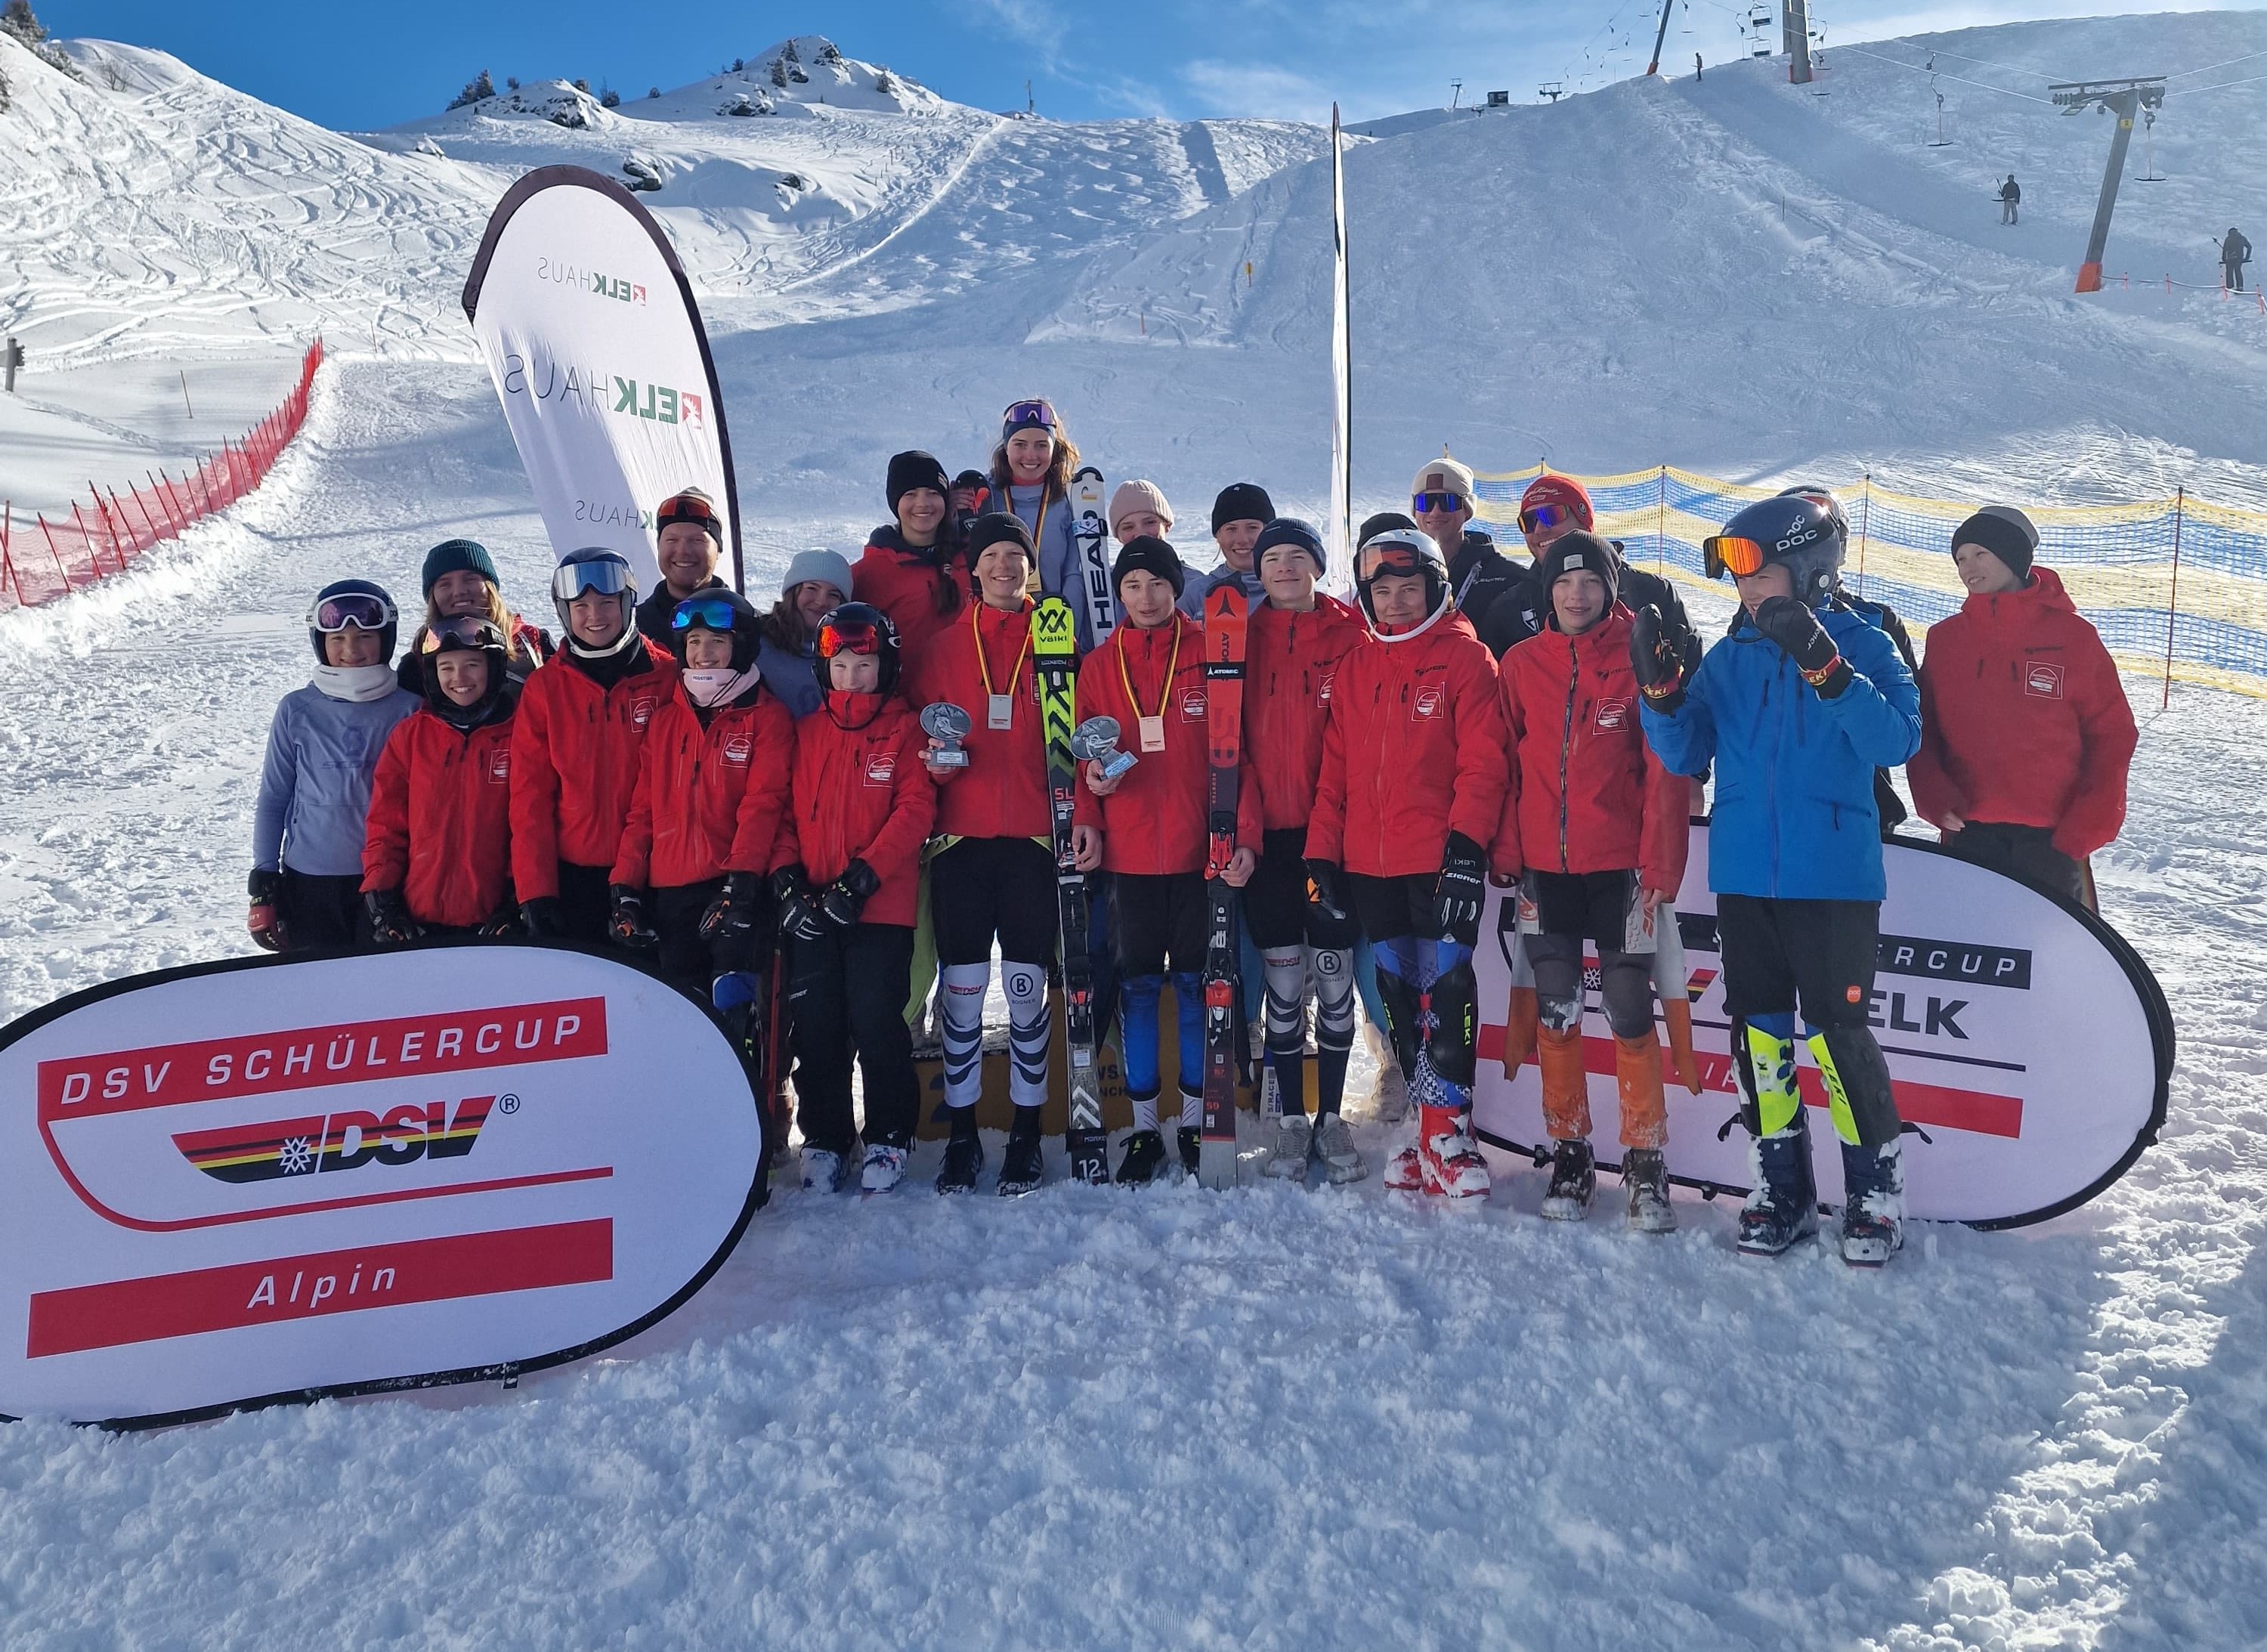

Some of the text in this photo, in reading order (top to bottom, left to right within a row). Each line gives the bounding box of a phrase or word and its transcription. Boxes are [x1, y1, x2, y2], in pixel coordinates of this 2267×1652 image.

[1776, 529, 1818, 552] POC
[60, 1014, 582, 1106] DSV SCHÜLERCUP
[320, 1095, 496, 1173] DSV
[1078, 1159, 1101, 1178] 12
[246, 1264, 397, 1310] Alpin
